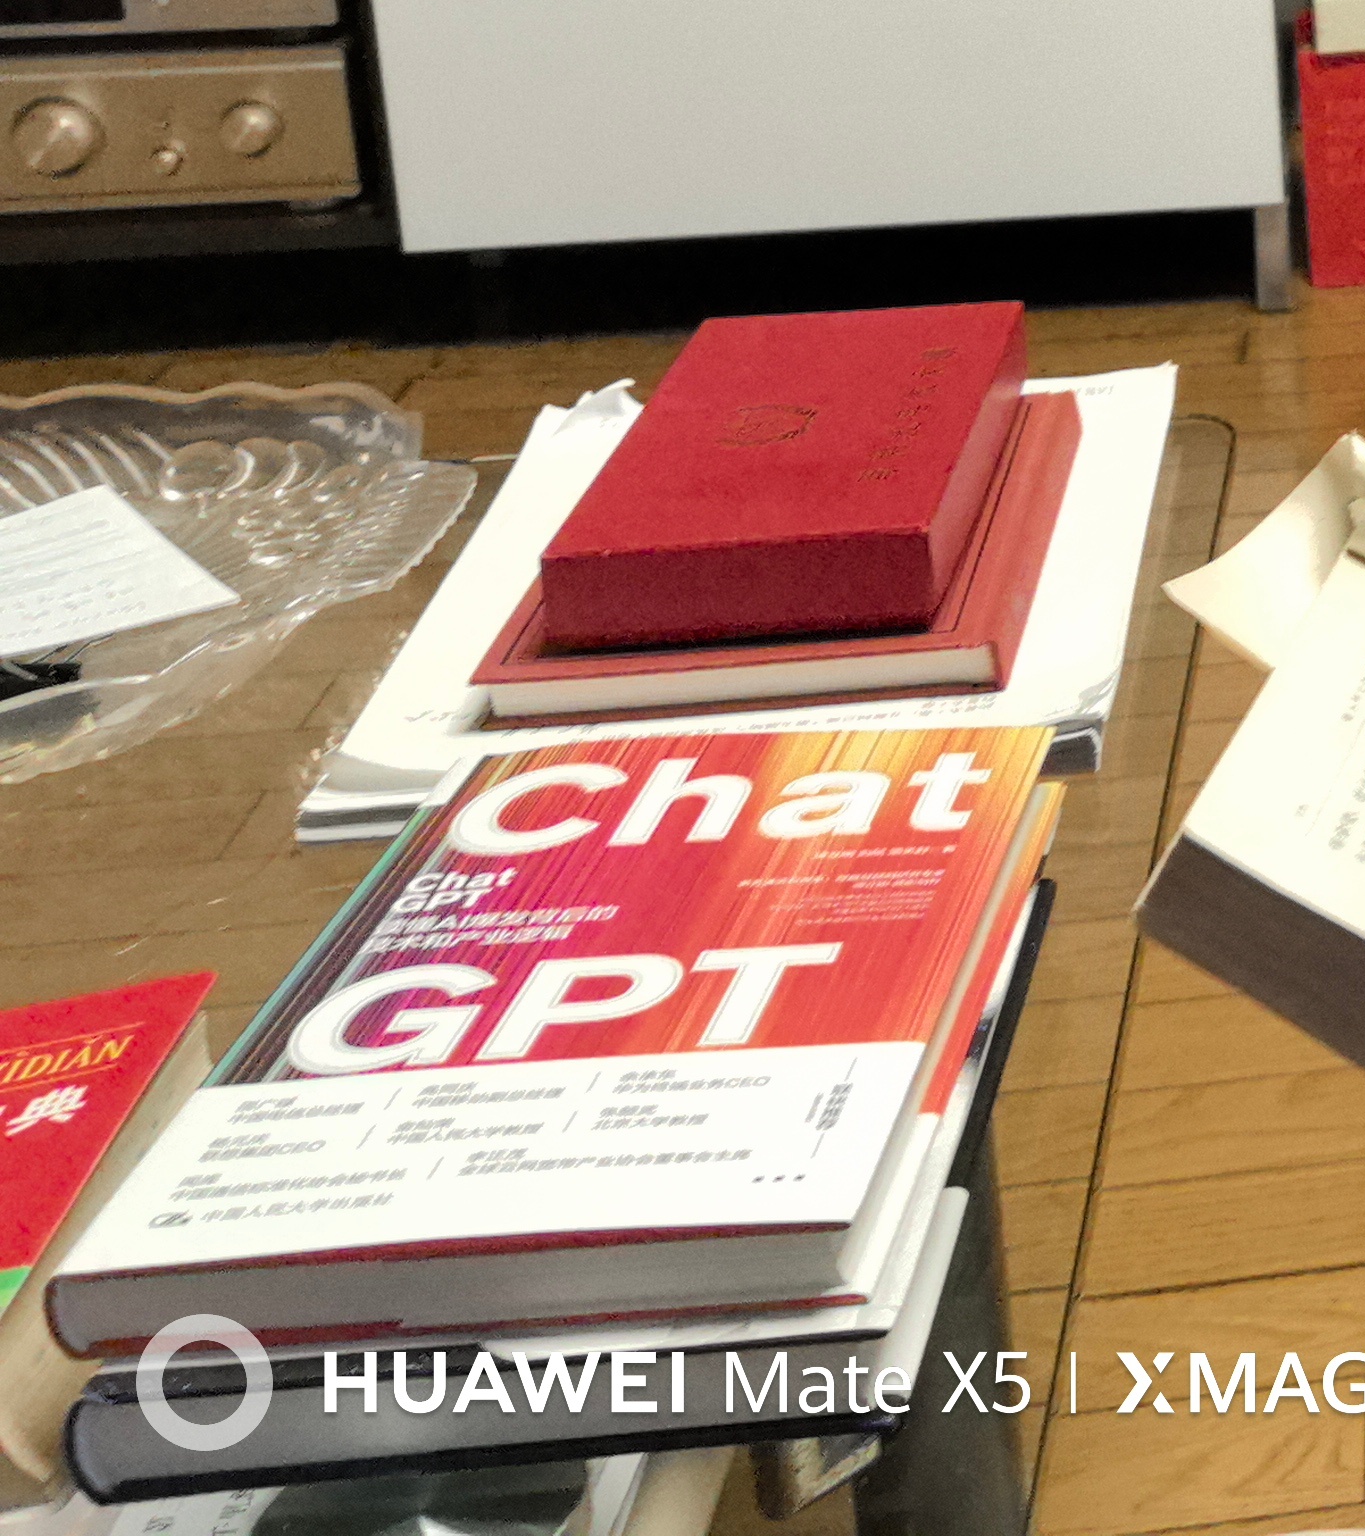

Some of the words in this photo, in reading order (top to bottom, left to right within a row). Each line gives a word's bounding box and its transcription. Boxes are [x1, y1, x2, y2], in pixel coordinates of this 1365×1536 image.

[450, 751, 993, 857] Chat
[391, 888, 492, 913] GPT
[408, 866, 518, 893] Chat
[287, 941, 844, 1076] GPT
[0, 1085, 88, 1136] 典
